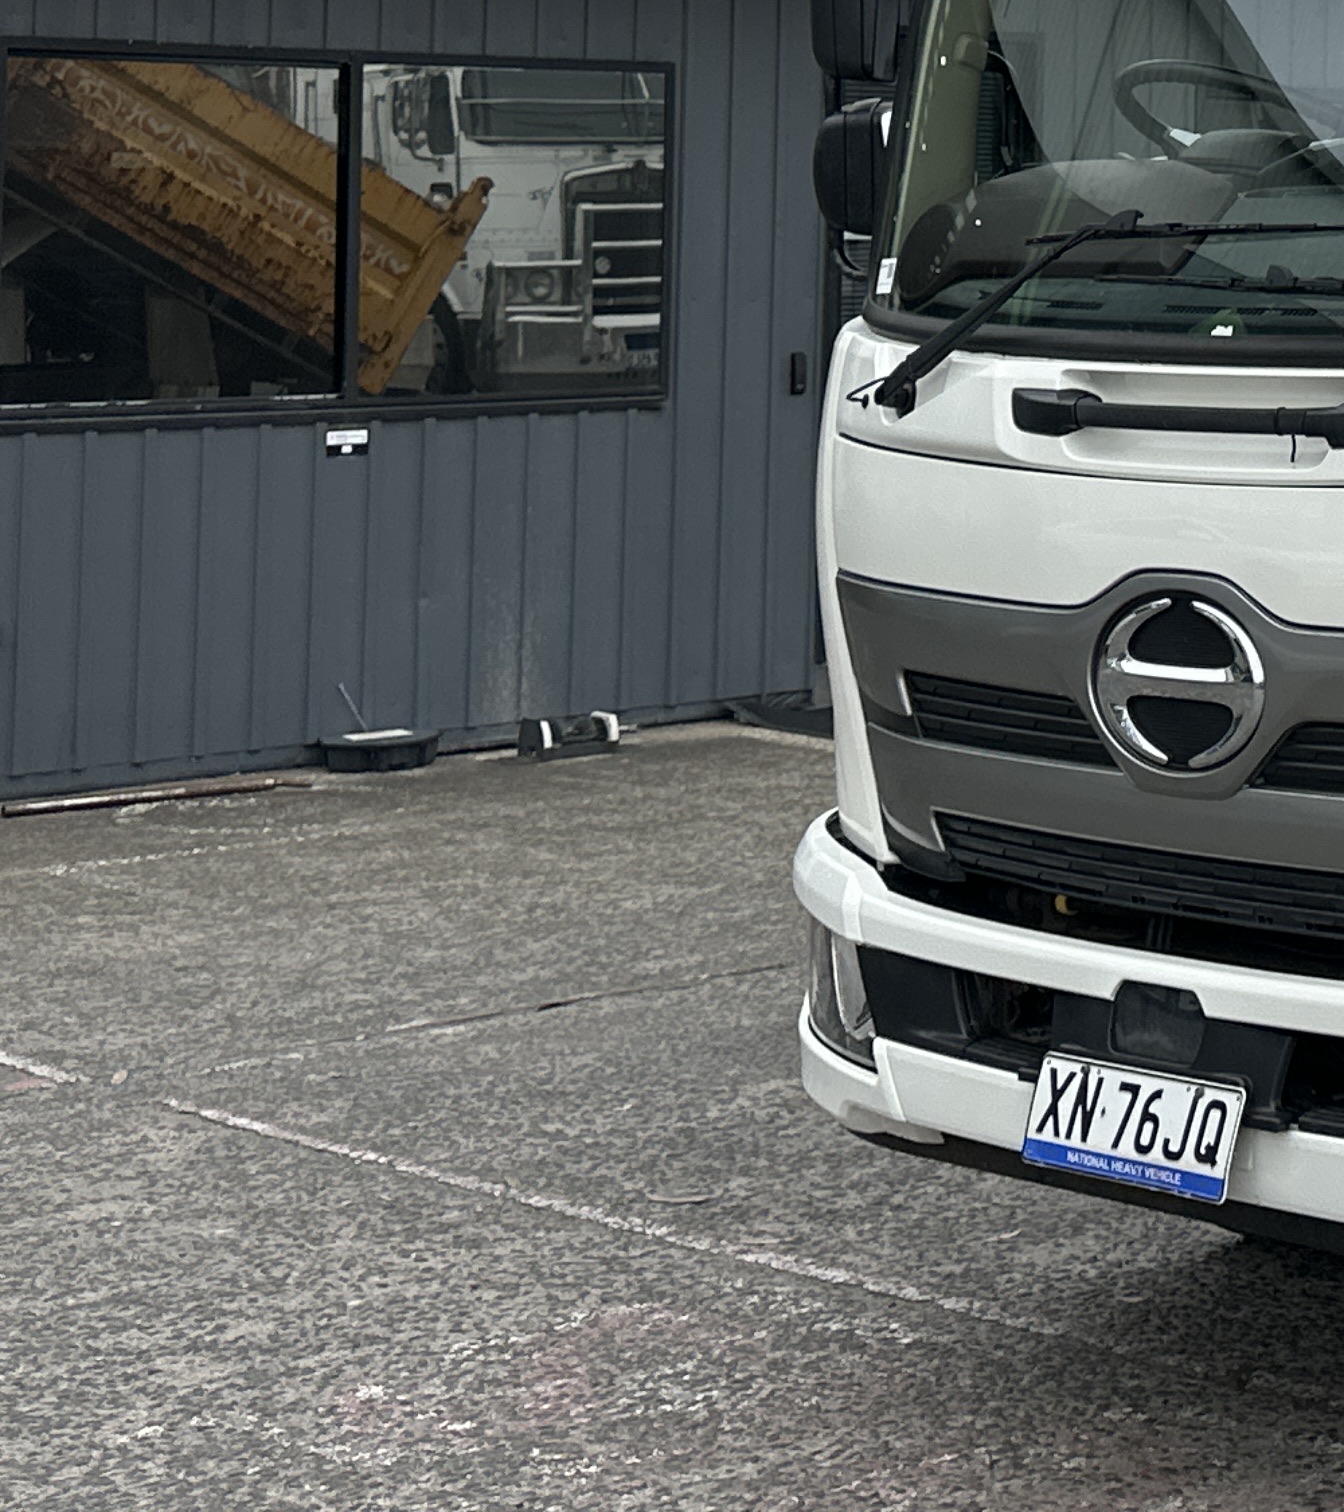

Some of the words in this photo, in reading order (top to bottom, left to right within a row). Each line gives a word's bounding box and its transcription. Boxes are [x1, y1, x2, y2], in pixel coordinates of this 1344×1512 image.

[1066, 1150, 1110, 1170] NATIONAL
[1110, 1160, 1143, 1178] HEAVY
[1144, 1166, 1182, 1186] VEHICLE
